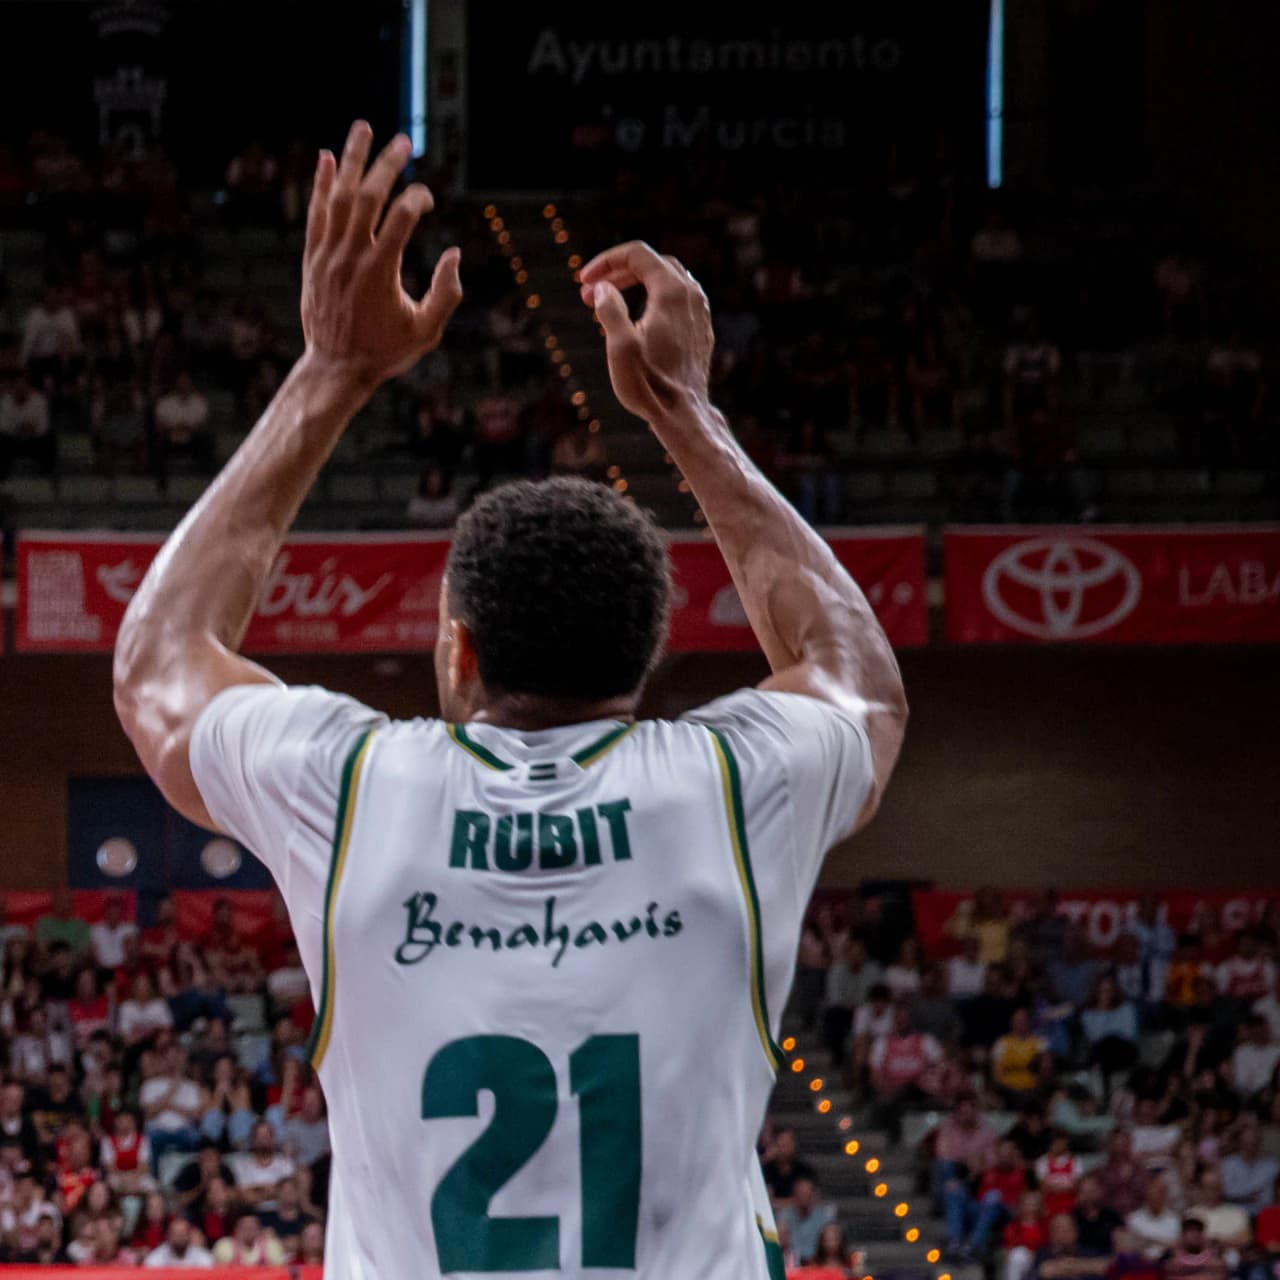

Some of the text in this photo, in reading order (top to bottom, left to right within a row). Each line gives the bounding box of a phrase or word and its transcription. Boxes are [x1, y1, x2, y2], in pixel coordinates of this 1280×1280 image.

[526, 24, 902, 88] Ayuntamiento
[448, 797, 633, 873] RUBIT
[395, 892, 684, 968] Benahavís
[421, 1033, 643, 1275] 21
